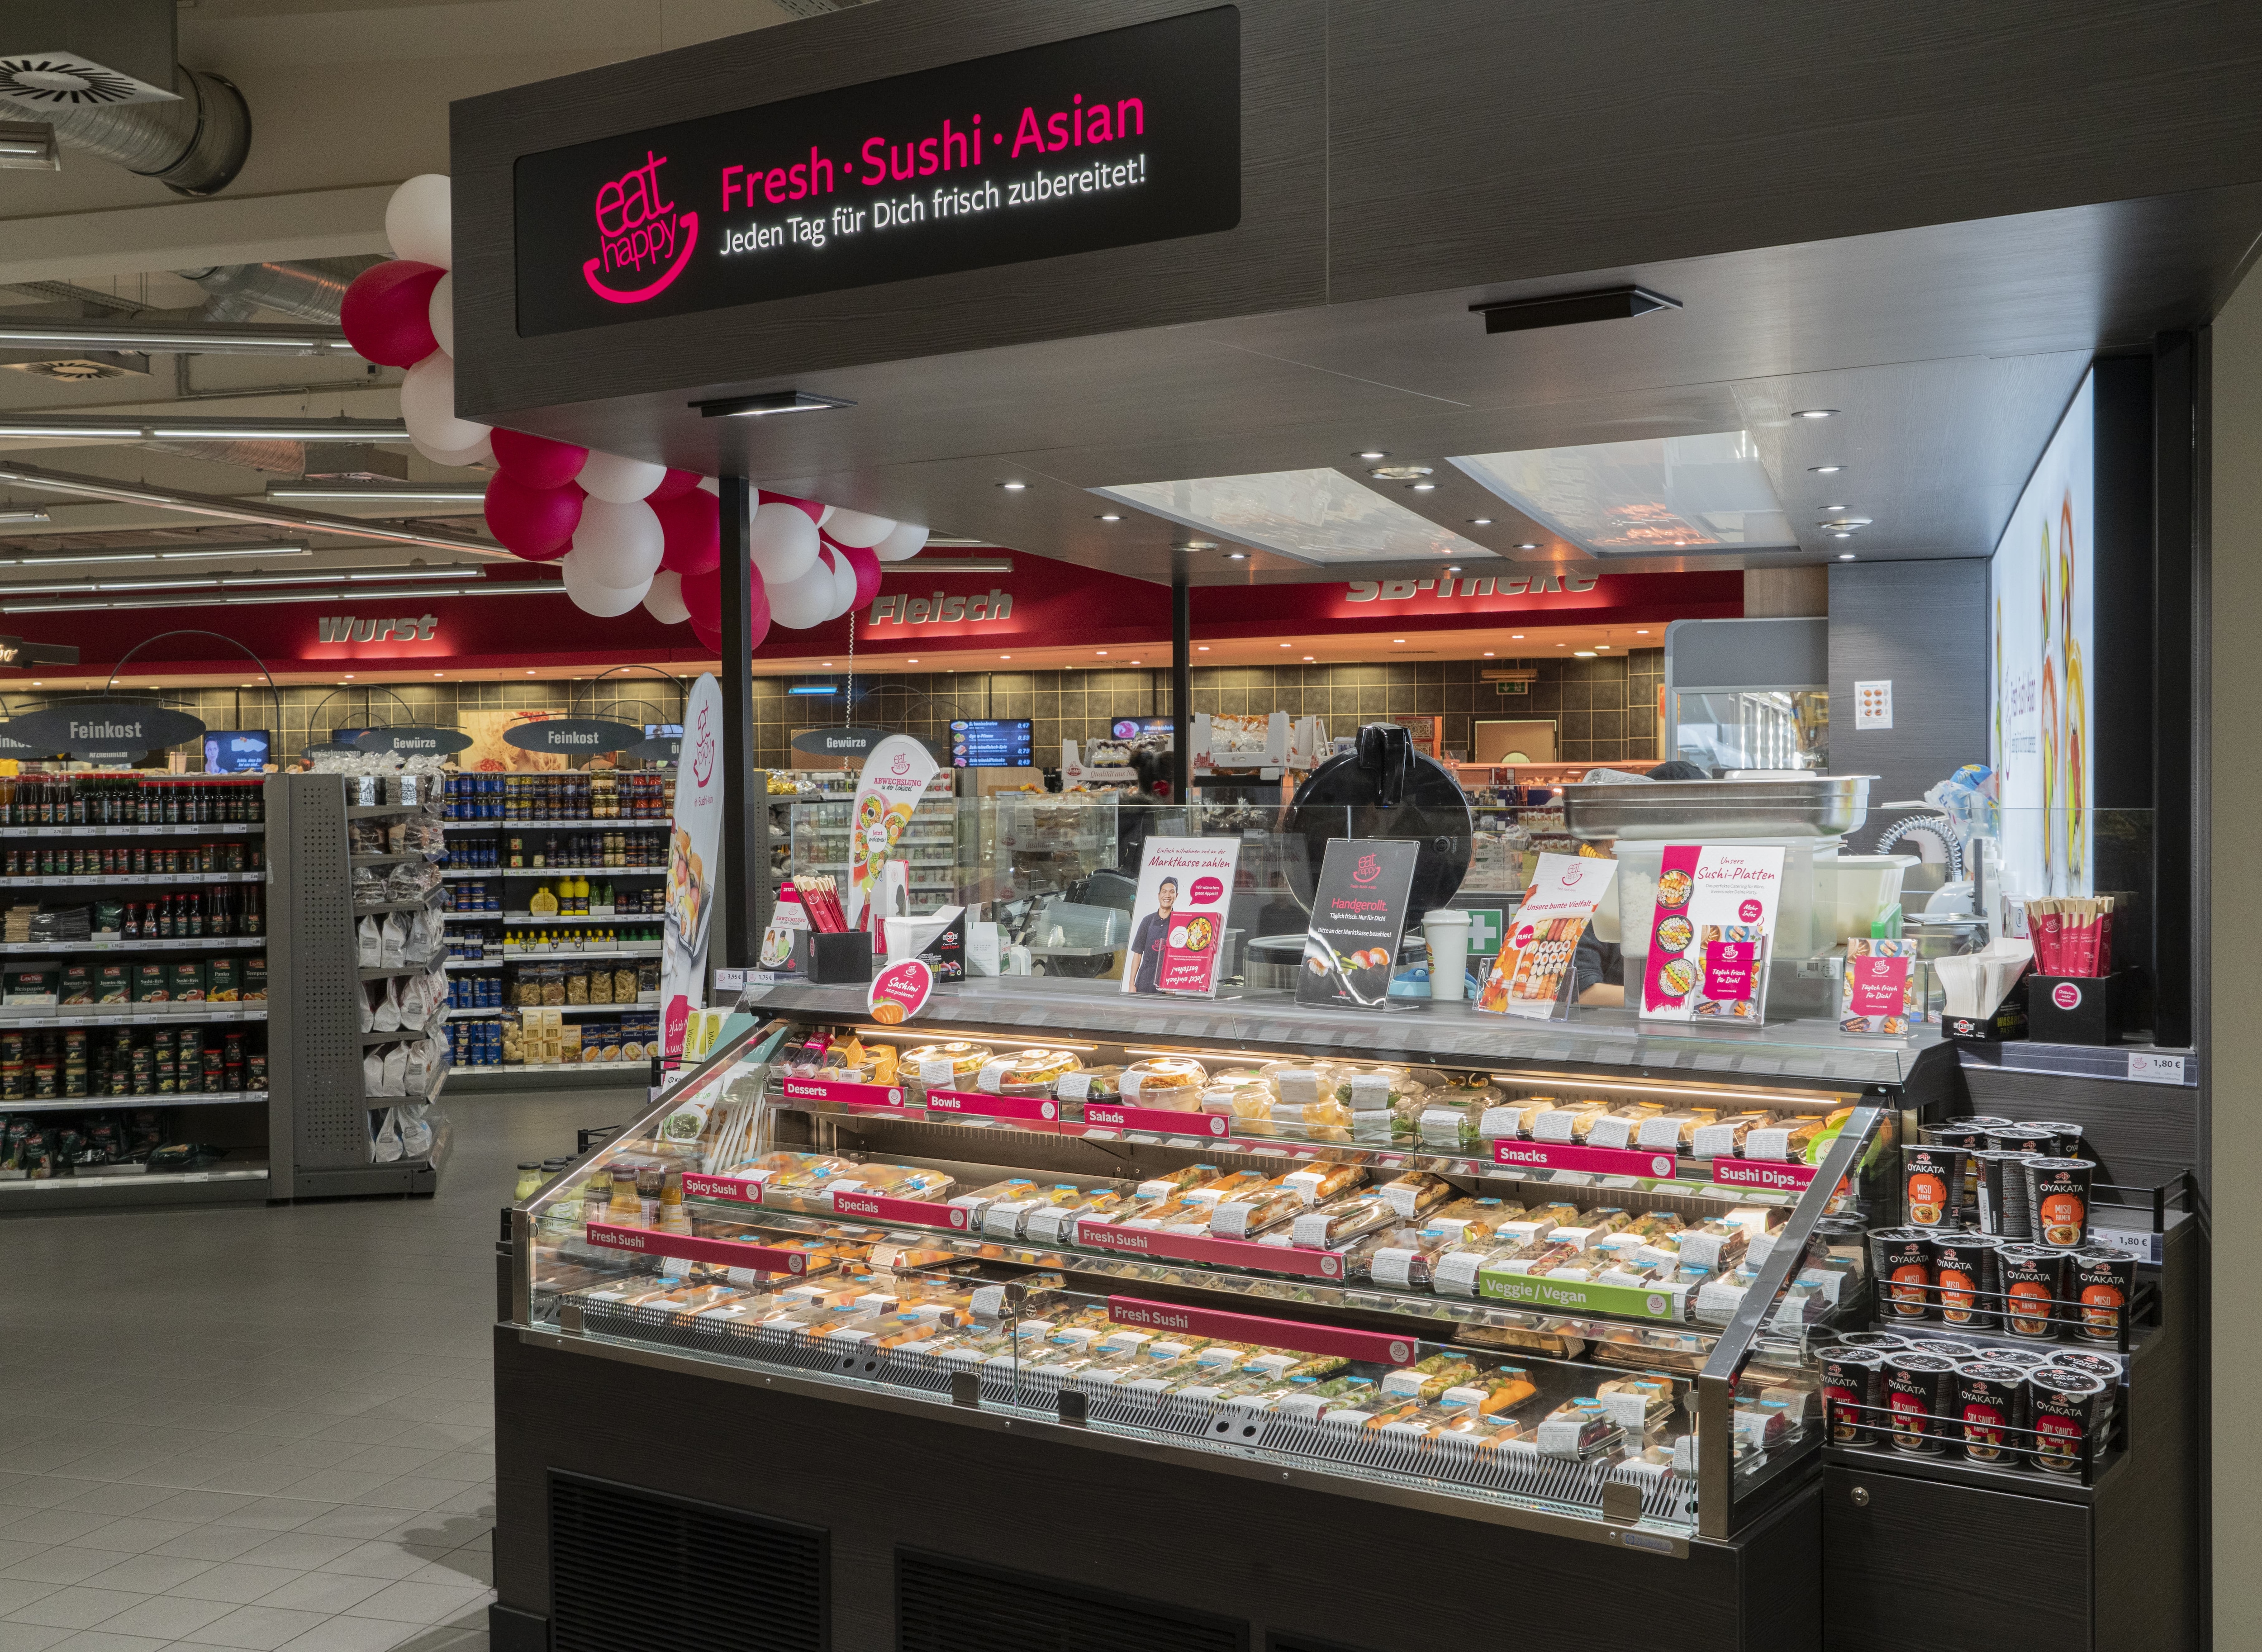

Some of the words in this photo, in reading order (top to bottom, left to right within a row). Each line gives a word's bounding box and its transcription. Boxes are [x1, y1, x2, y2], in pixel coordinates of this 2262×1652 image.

[721, 146, 833, 211] Fresh
[861, 115, 980, 185] Sushi
[1012, 93, 1144, 159] Asian
[595, 151, 674, 237] eat
[720, 223, 783, 255] Jeden
[787, 215, 825, 247] Tag
[832, 207, 865, 236] für
[873, 196, 924, 229] Dich
[933, 182, 999, 218] frisch
[1007, 154, 1146, 205] zubereitet!
[601, 212, 679, 272] happy
[870, 589, 1013, 626] Fleisch
[318, 614, 438, 643] Wurst
[70, 722, 142, 739] Feinkost
[394, 737, 436, 749] Gewürze
[548, 732, 599, 744] Feinkost
[827, 736, 866, 749] Gewürze
[894, 753, 906, 764] eat
[1091, 770, 1113, 778] Qualität
[874, 778, 922, 786] ABWECHSLUNG
[1149, 856, 1199, 867] Marktkasse
[1202, 858, 1230, 868] zahlen
[1358, 852, 1377, 868] eat
[1720, 857, 1744, 865] Unsere
[1358, 866, 1376, 876] happy
[1567, 861, 1582, 873] eat
[1698, 867, 1775, 880] Sushi-Platten
[1332, 898, 1388, 913] Handgerollt.
[2047, 919, 2057, 927] eat
[888, 977, 920, 992] Sashimi
[894, 990, 914, 998] probieren!
[684, 1029, 694, 1059] Wasabi
[2153, 1059, 2172, 1068] 1,80
[788, 1083, 827, 1096] Desserts
[931, 1097, 960, 1109] Bowls
[1090, 1110, 1124, 1123] Salads
[1501, 1148, 1547, 1163] Snacks
[1908, 1163, 1945, 1174] OYAKATA
[1720, 1167, 1759, 1182] Sushi
[1763, 1170, 1794, 1187] Dips
[686, 1179, 711, 1196] Spicy
[713, 1182, 737, 1196] Sushi
[1917, 1184, 1931, 1194] MISO
[2040, 1183, 2083, 1192] OYAKATA
[838, 1198, 879, 1214] Specials
[2055, 1205, 2071, 1215] MISO
[591, 1230, 617, 1244] Fresh
[618, 1234, 644, 1248] Sushi
[1083, 1229, 1114, 1244] Fresh
[1117, 1234, 1148, 1248] Sushi
[2119, 1237, 2139, 1246] 1,80
[1890, 1255, 1929, 1263] OYAKATA
[1937, 1259, 1972, 1270] OYAKATA
[1905, 1275, 1919, 1283] MISO
[2008, 1271, 2050, 1281] OYAKATA
[2081, 1274, 2124, 1284] OYAKATA
[1946, 1281, 1959, 1289] MISO
[1486, 1279, 1532, 1299] Veggie
[1543, 1286, 1587, 1305] Vegan
[2094, 1296, 2110, 1305] MISO
[1115, 1305, 1150, 1323] Fresh
[1152, 1312, 1188, 1329] Sushi
[1820, 1374, 1857, 1387] OYAKATA
[1888, 1379, 1926, 1395] OYAKATA
[1962, 1391, 2003, 1405] OYAKATA
[1901, 1404, 1918, 1413] SAUCE
[2037, 1401, 2082, 1416] OYAKATA
[1968, 1413, 1977, 1422] SOY
[1978, 1415, 1996, 1424] SAUCE
[2043, 1423, 2053, 1433] SOY
[2055, 1426, 2073, 1435] SAUCE
